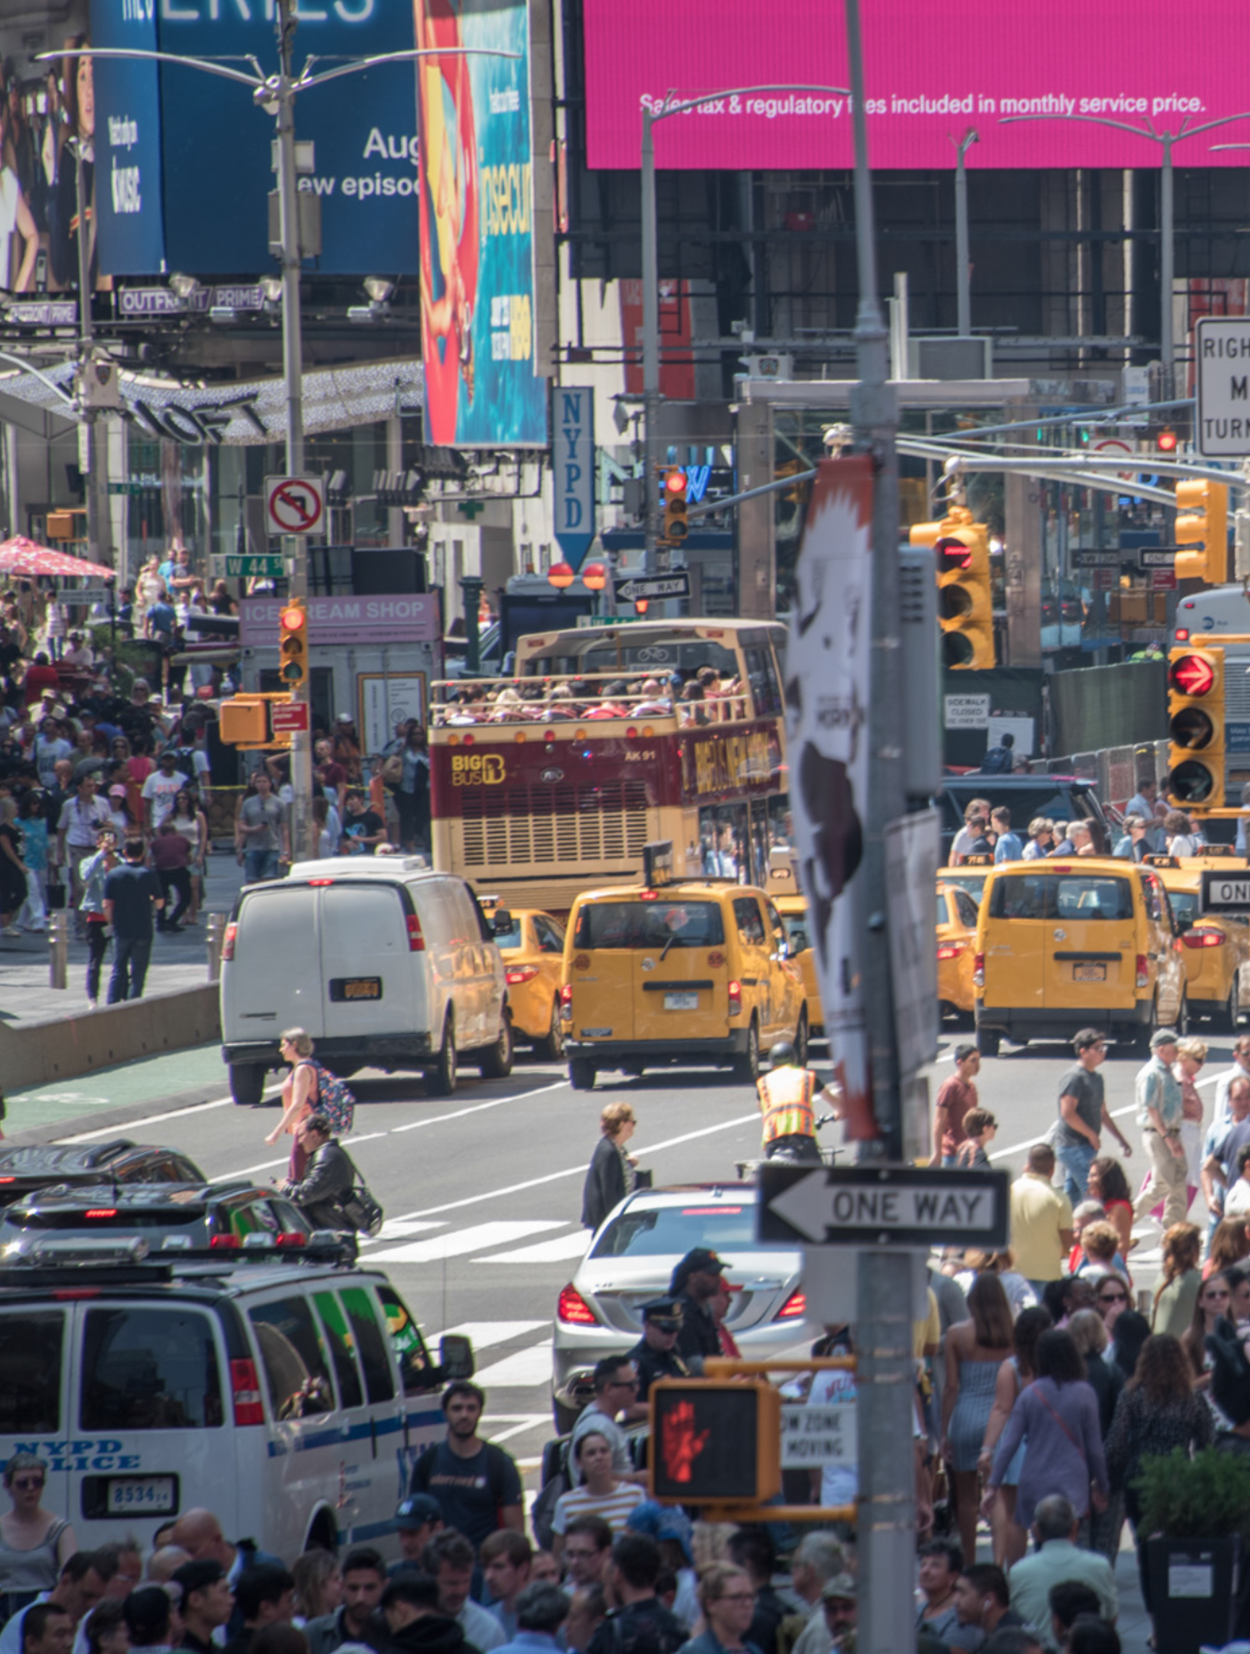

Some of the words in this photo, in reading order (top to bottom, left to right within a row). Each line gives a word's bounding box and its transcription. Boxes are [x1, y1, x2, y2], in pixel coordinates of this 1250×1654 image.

[639, 93, 693, 115] Sales
[697, 97, 725, 115] tax
[728, 95, 742, 114] &
[746, 95, 843, 118] regulatory
[847, 95, 887, 115] fes
[891, 93, 973, 115] included
[978, 93, 996, 114] in
[1000, 93, 1076, 116] monthly
[1079, 93, 1148, 113] service
[1152, 92, 1207, 116] price.
[297, 178, 335, 196] ew
[216, 288, 262, 308] PRIME
[562, 393, 583, 528] NYPD
[228, 560, 244, 575] W
[249, 560, 268, 575] 44
[624, 582, 650, 596] ONE
[656, 577, 682, 592] WAY
[245, 605, 278, 622] ICE
[305, 602, 360, 620] REAM
[366, 602, 425, 619] SHOP
[947, 699, 987, 707] SIDEWALK
[951, 708, 984, 716] CLOSED
[452, 754, 482, 771] BIG
[625, 751, 641, 761] AK
[642, 750, 656, 760] 91
[452, 771, 483, 787] BUS
[833, 1191, 899, 1223] ONE
[913, 1192, 983, 1224] WAY
[805, 1412, 842, 1432] ZONE
[14, 1439, 123, 1456] NYPD
[787, 1438, 842, 1458] MOVING
